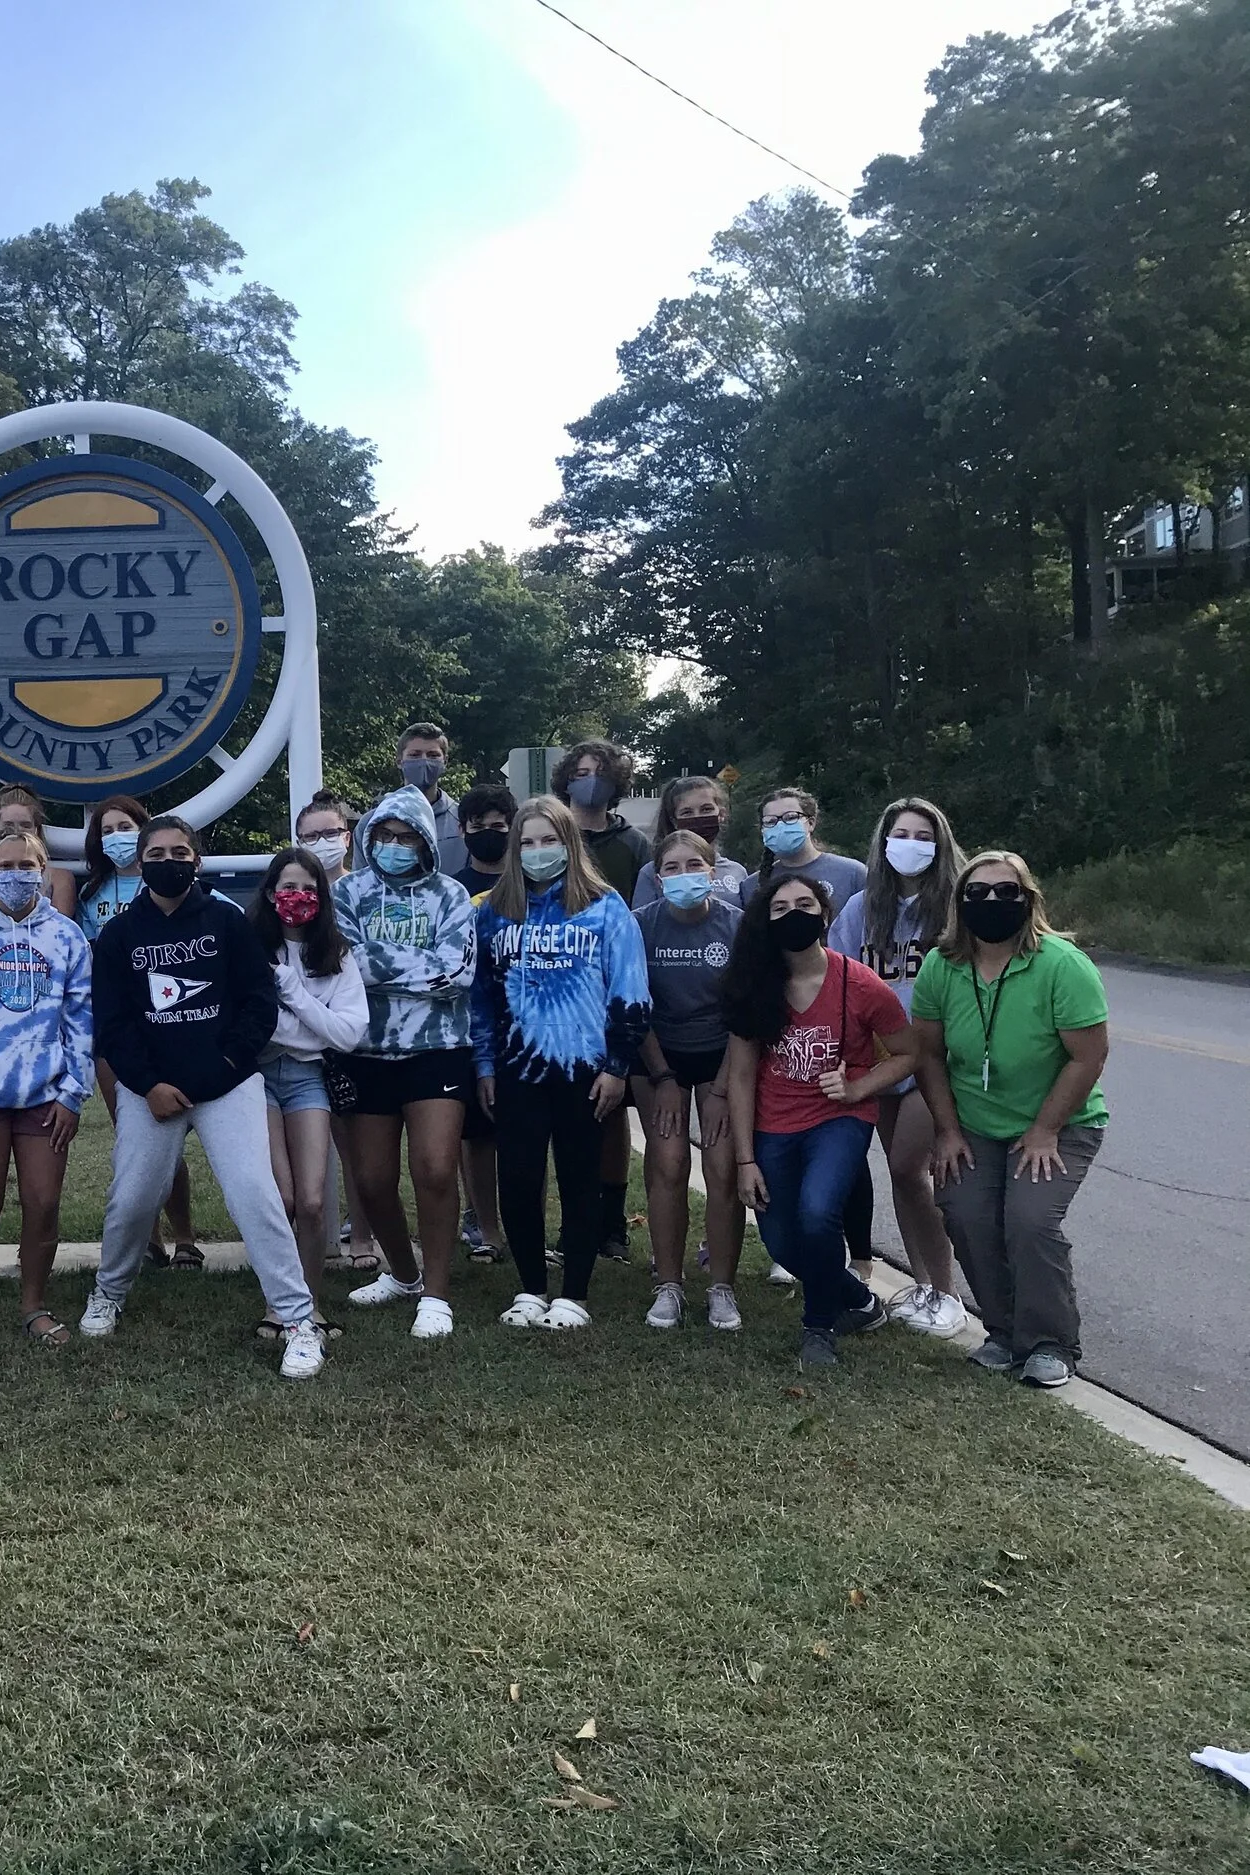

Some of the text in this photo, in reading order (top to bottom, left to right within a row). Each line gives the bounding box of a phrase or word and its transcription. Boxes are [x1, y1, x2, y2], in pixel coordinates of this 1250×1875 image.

[23, 611, 157, 660] GAP
[126, 666, 224, 762] PARK
[131, 935, 218, 972] SJRYC
[492, 923, 599, 966] TRAVERSE CITY
[655, 946, 703, 959] Interact
[509, 958, 573, 970] MICHIGAN
[145, 1010, 183, 1024] SWIM
